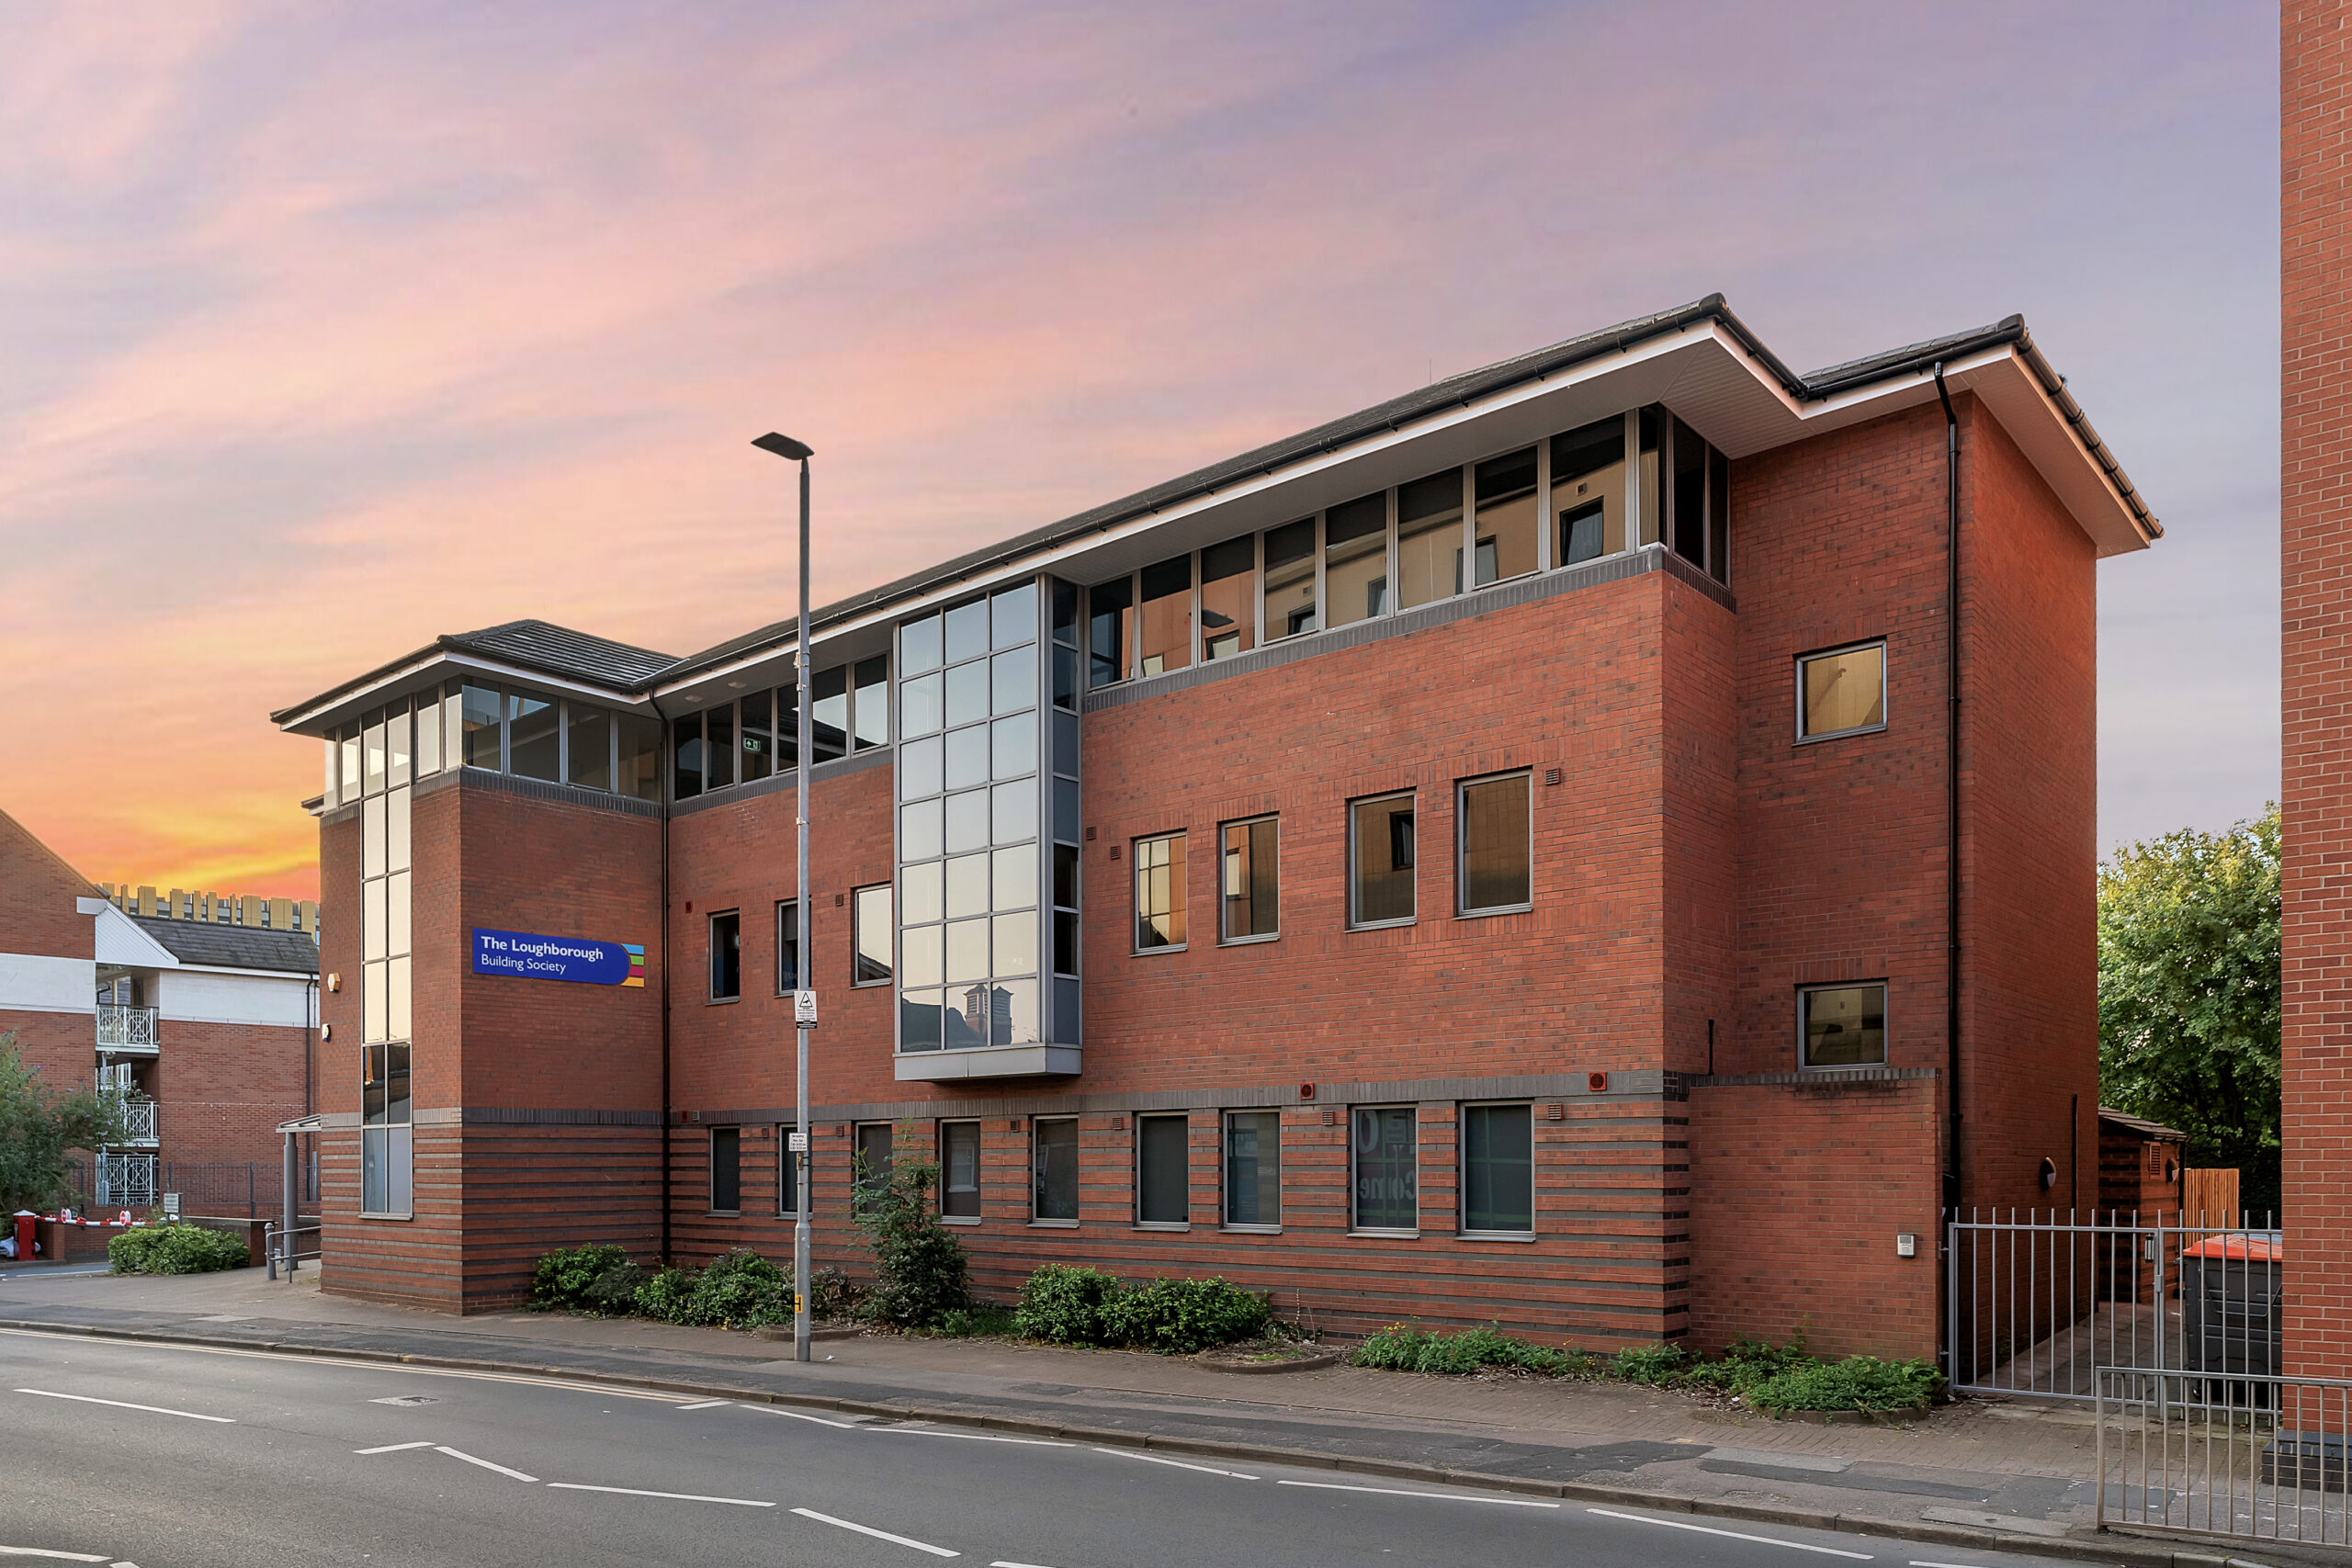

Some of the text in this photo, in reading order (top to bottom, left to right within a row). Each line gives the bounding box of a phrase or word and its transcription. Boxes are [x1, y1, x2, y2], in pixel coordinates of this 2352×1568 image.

[481, 936, 604, 962] The Loughborough
[481, 953, 566, 975] Building Society
